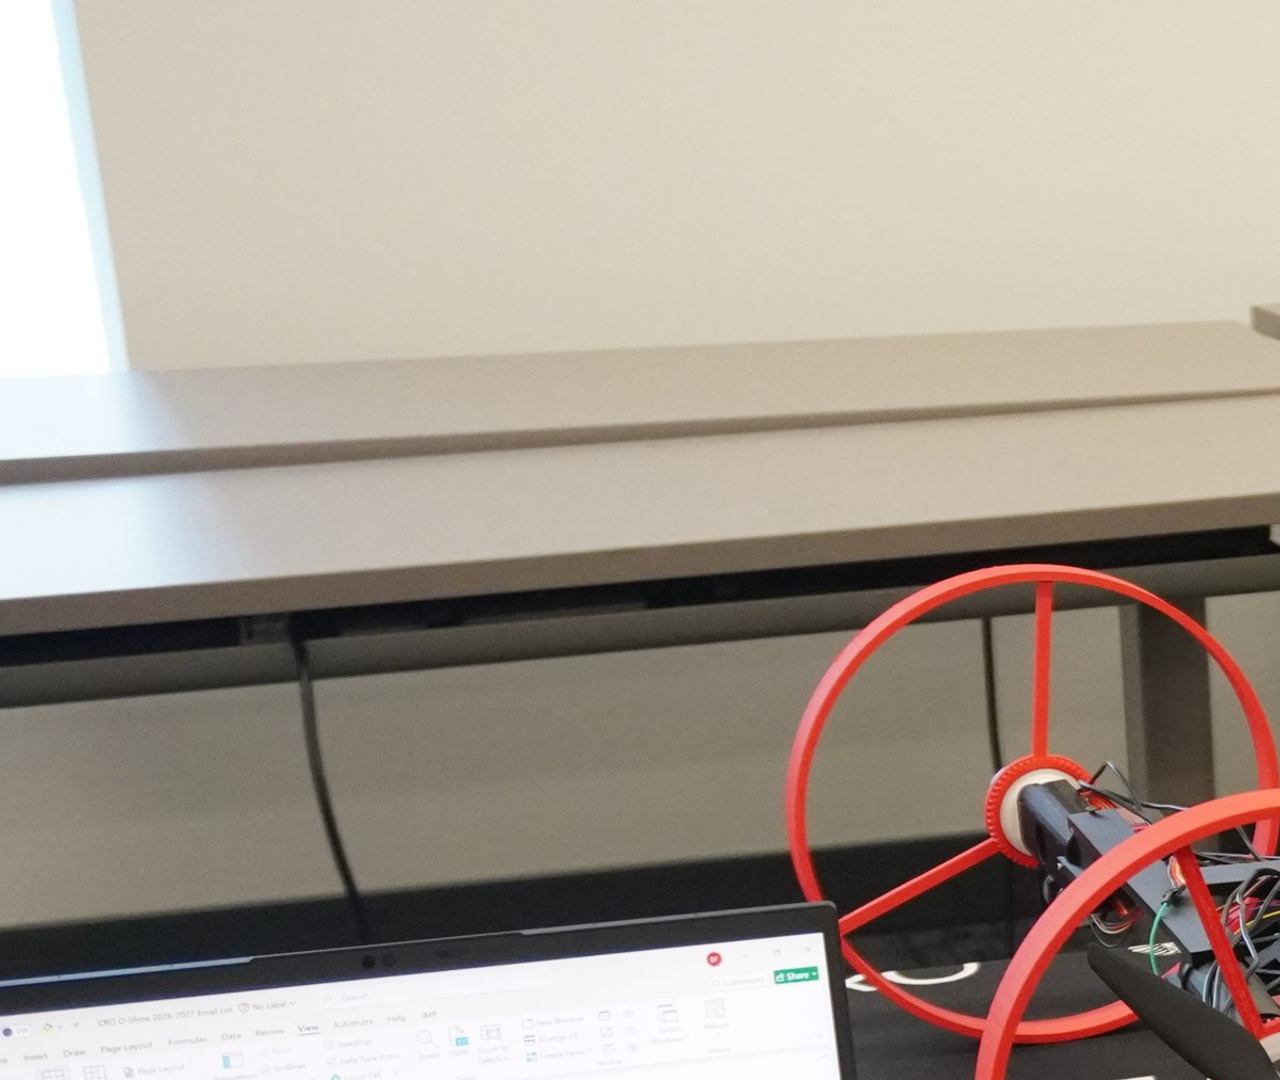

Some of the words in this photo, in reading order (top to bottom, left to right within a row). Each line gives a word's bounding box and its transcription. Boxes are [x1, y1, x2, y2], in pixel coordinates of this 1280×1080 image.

[786, 972, 810, 981] Share
[198, 1008, 219, 1017] Email
[297, 1023, 319, 1033] View
